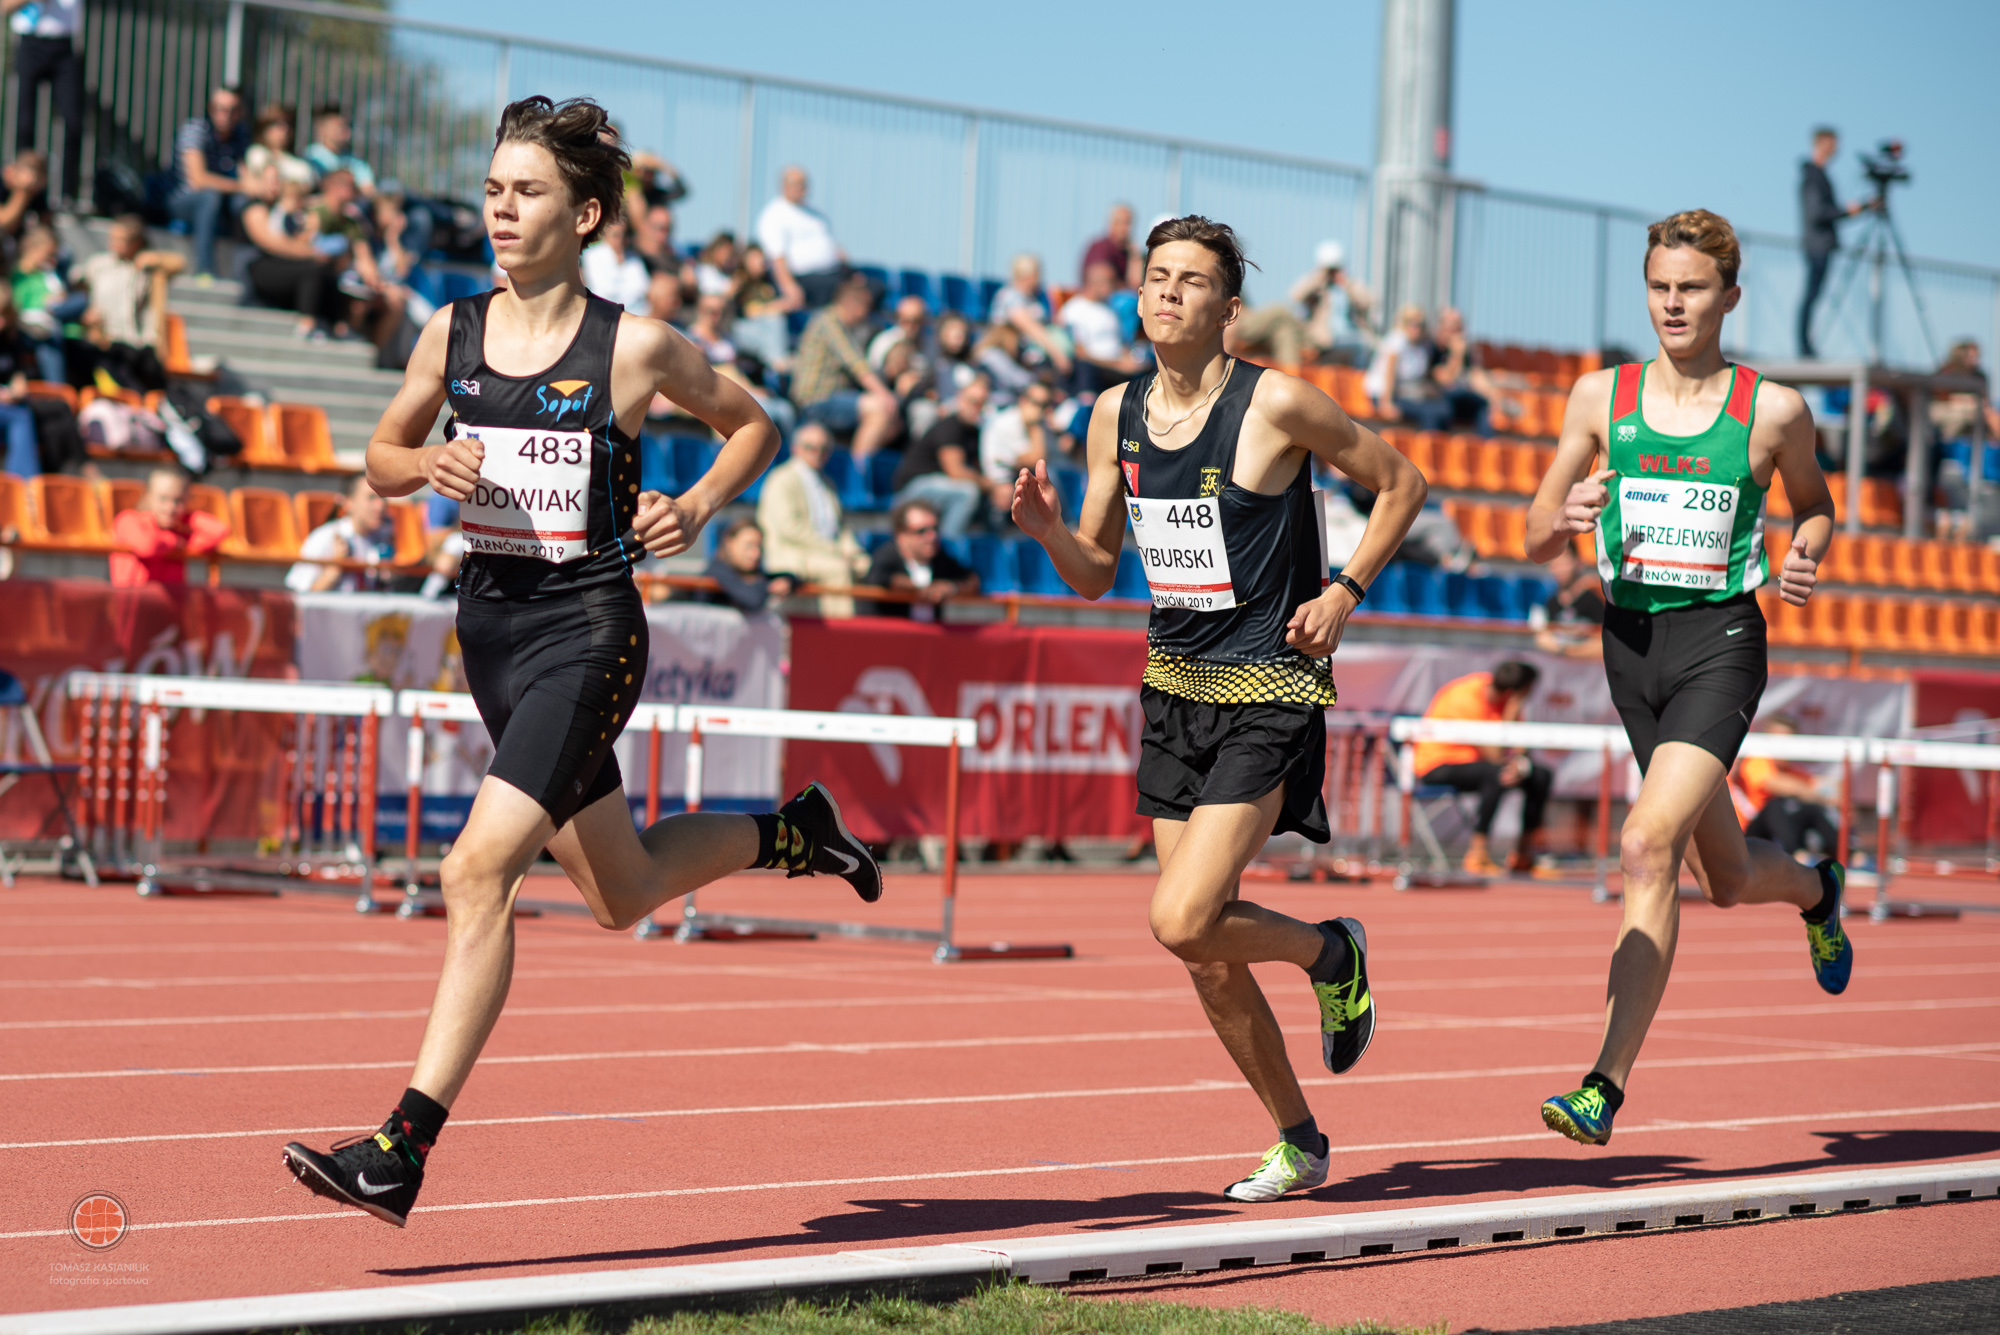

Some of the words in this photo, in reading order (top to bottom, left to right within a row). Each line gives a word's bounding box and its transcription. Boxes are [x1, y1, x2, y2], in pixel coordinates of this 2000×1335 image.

[536, 385, 593, 422] Sopot
[517, 436, 583, 465] 483
[1122, 438, 1140, 453] esa
[1638, 453, 1711, 474] WLKS
[466, 484, 583, 513] DOWIAK
[1683, 488, 1733, 512] 288
[1166, 504, 1214, 529] 448
[469, 537, 527, 553] TARNÓW
[531, 545, 565, 559] 2019
[1625, 523, 1729, 550] MIERZEJEWSKI
[1138, 547, 1214, 569] YBURSKI
[1634, 567, 1681, 583] TARNÓW
[1685, 574, 1711, 586] 2019
[1152, 593, 1185, 607] ARNÓW
[1187, 597, 1213, 608] 2019
[974, 702, 1130, 754] ORLEN
